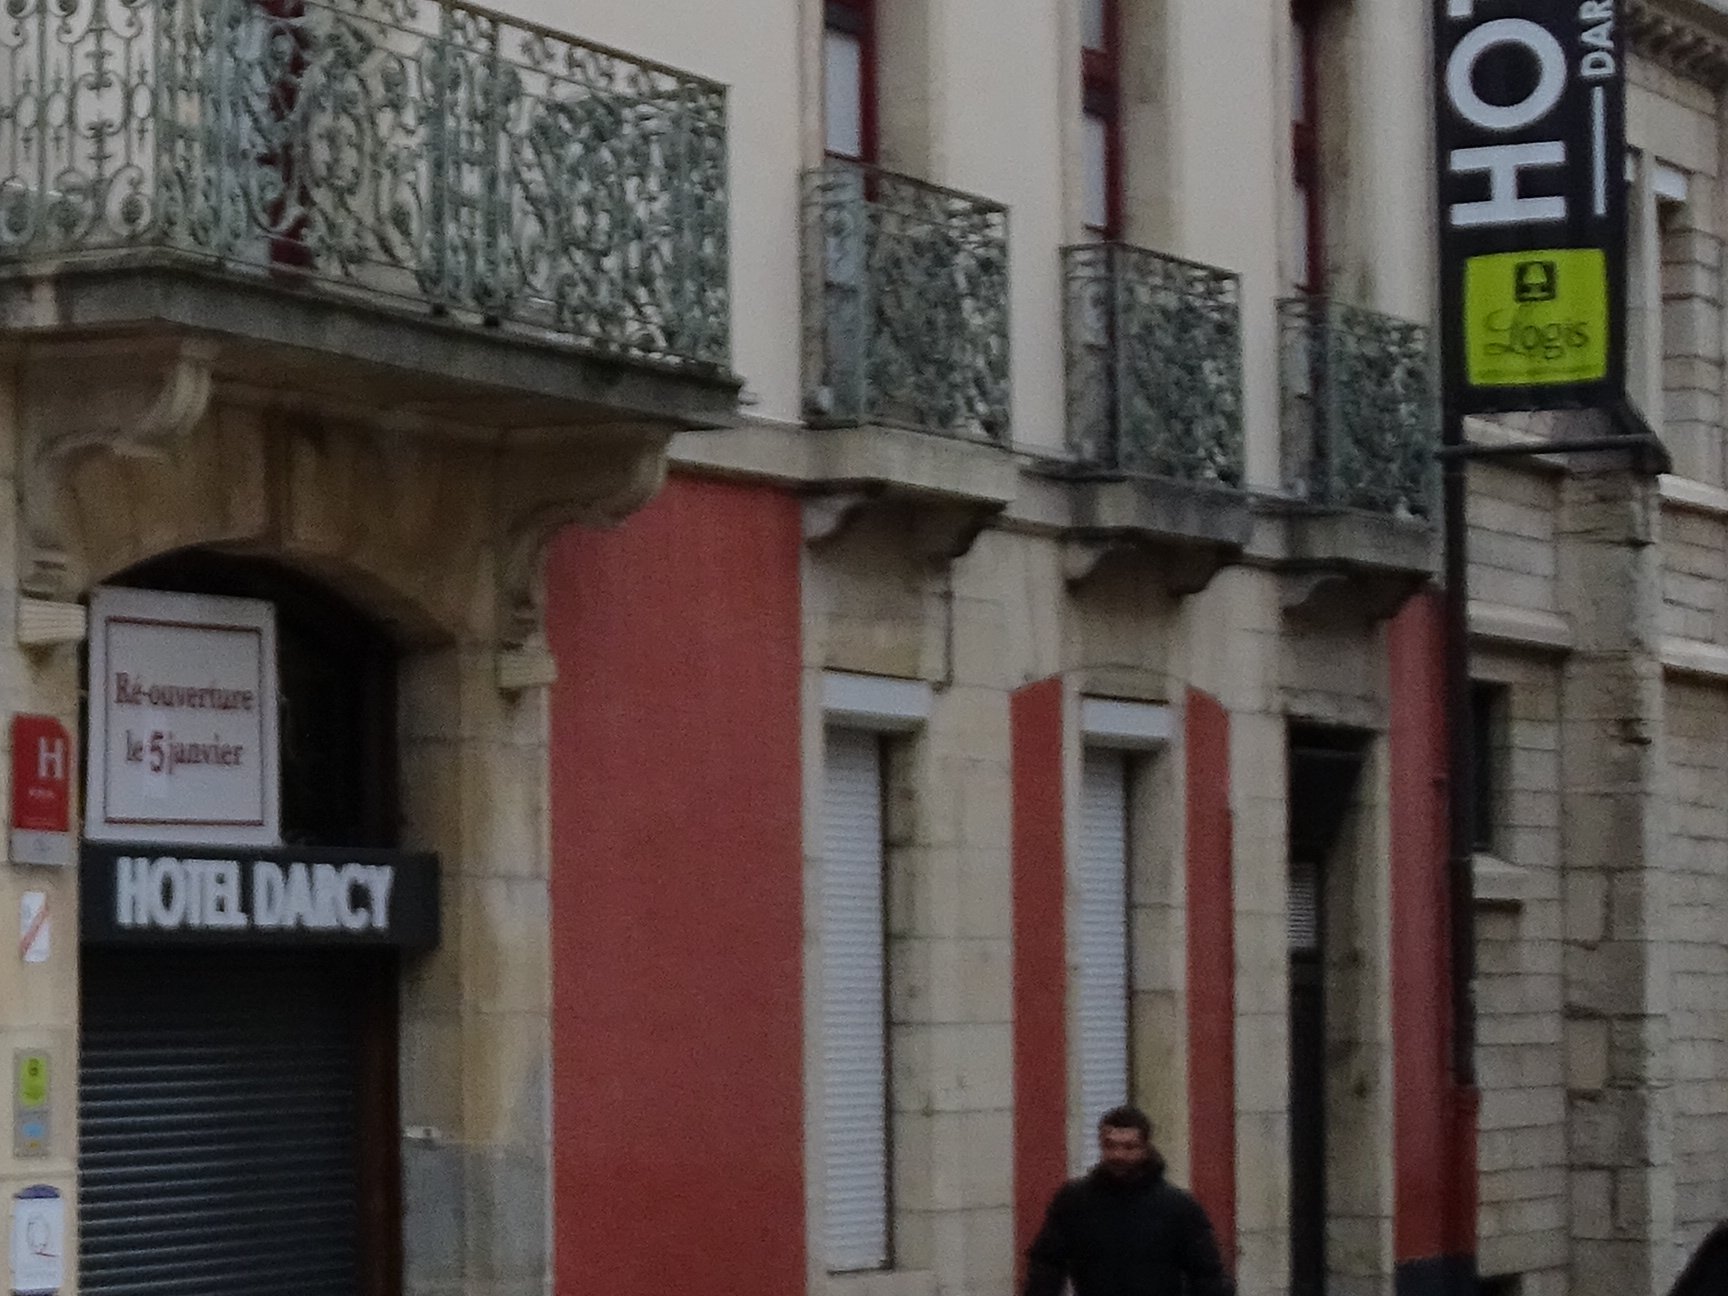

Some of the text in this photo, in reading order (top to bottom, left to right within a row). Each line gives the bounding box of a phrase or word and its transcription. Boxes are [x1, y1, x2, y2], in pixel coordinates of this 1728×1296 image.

[37, 735, 65, 780] H
[125, 730, 244, 775] le 5 janvier
[116, 855, 394, 931] HOTEL DARCY
